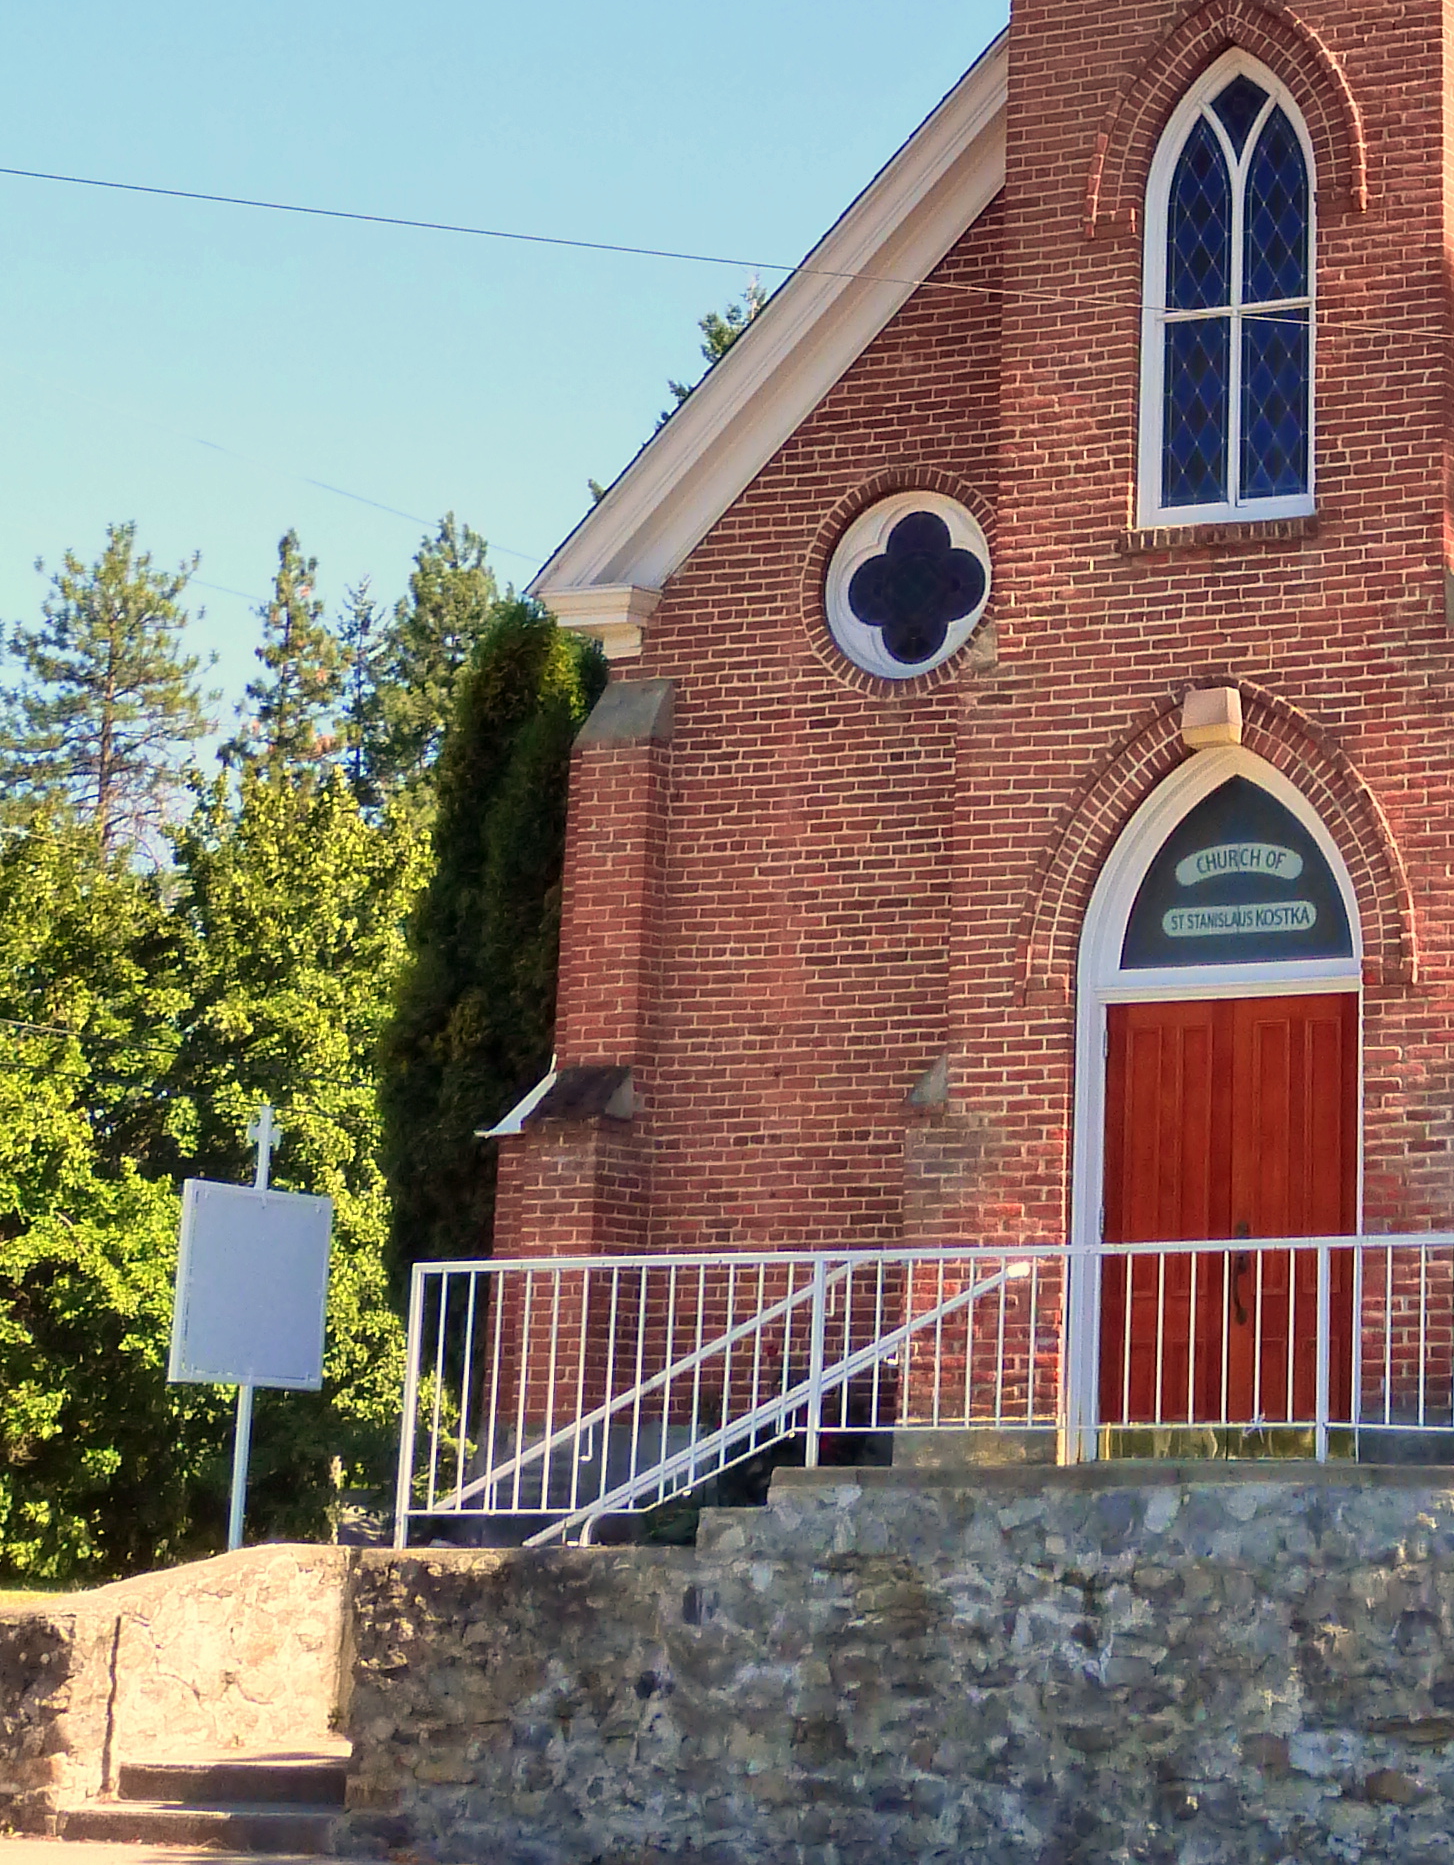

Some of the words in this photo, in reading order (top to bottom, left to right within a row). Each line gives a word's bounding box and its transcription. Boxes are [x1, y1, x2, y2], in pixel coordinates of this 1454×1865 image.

[1196, 848, 1261, 874] CHURCH
[1265, 851, 1288, 870] OF
[1170, 914, 1185, 931] ST
[1187, 910, 1253, 929] STANISLAUS
[1255, 907, 1310, 927] KOSTKA
